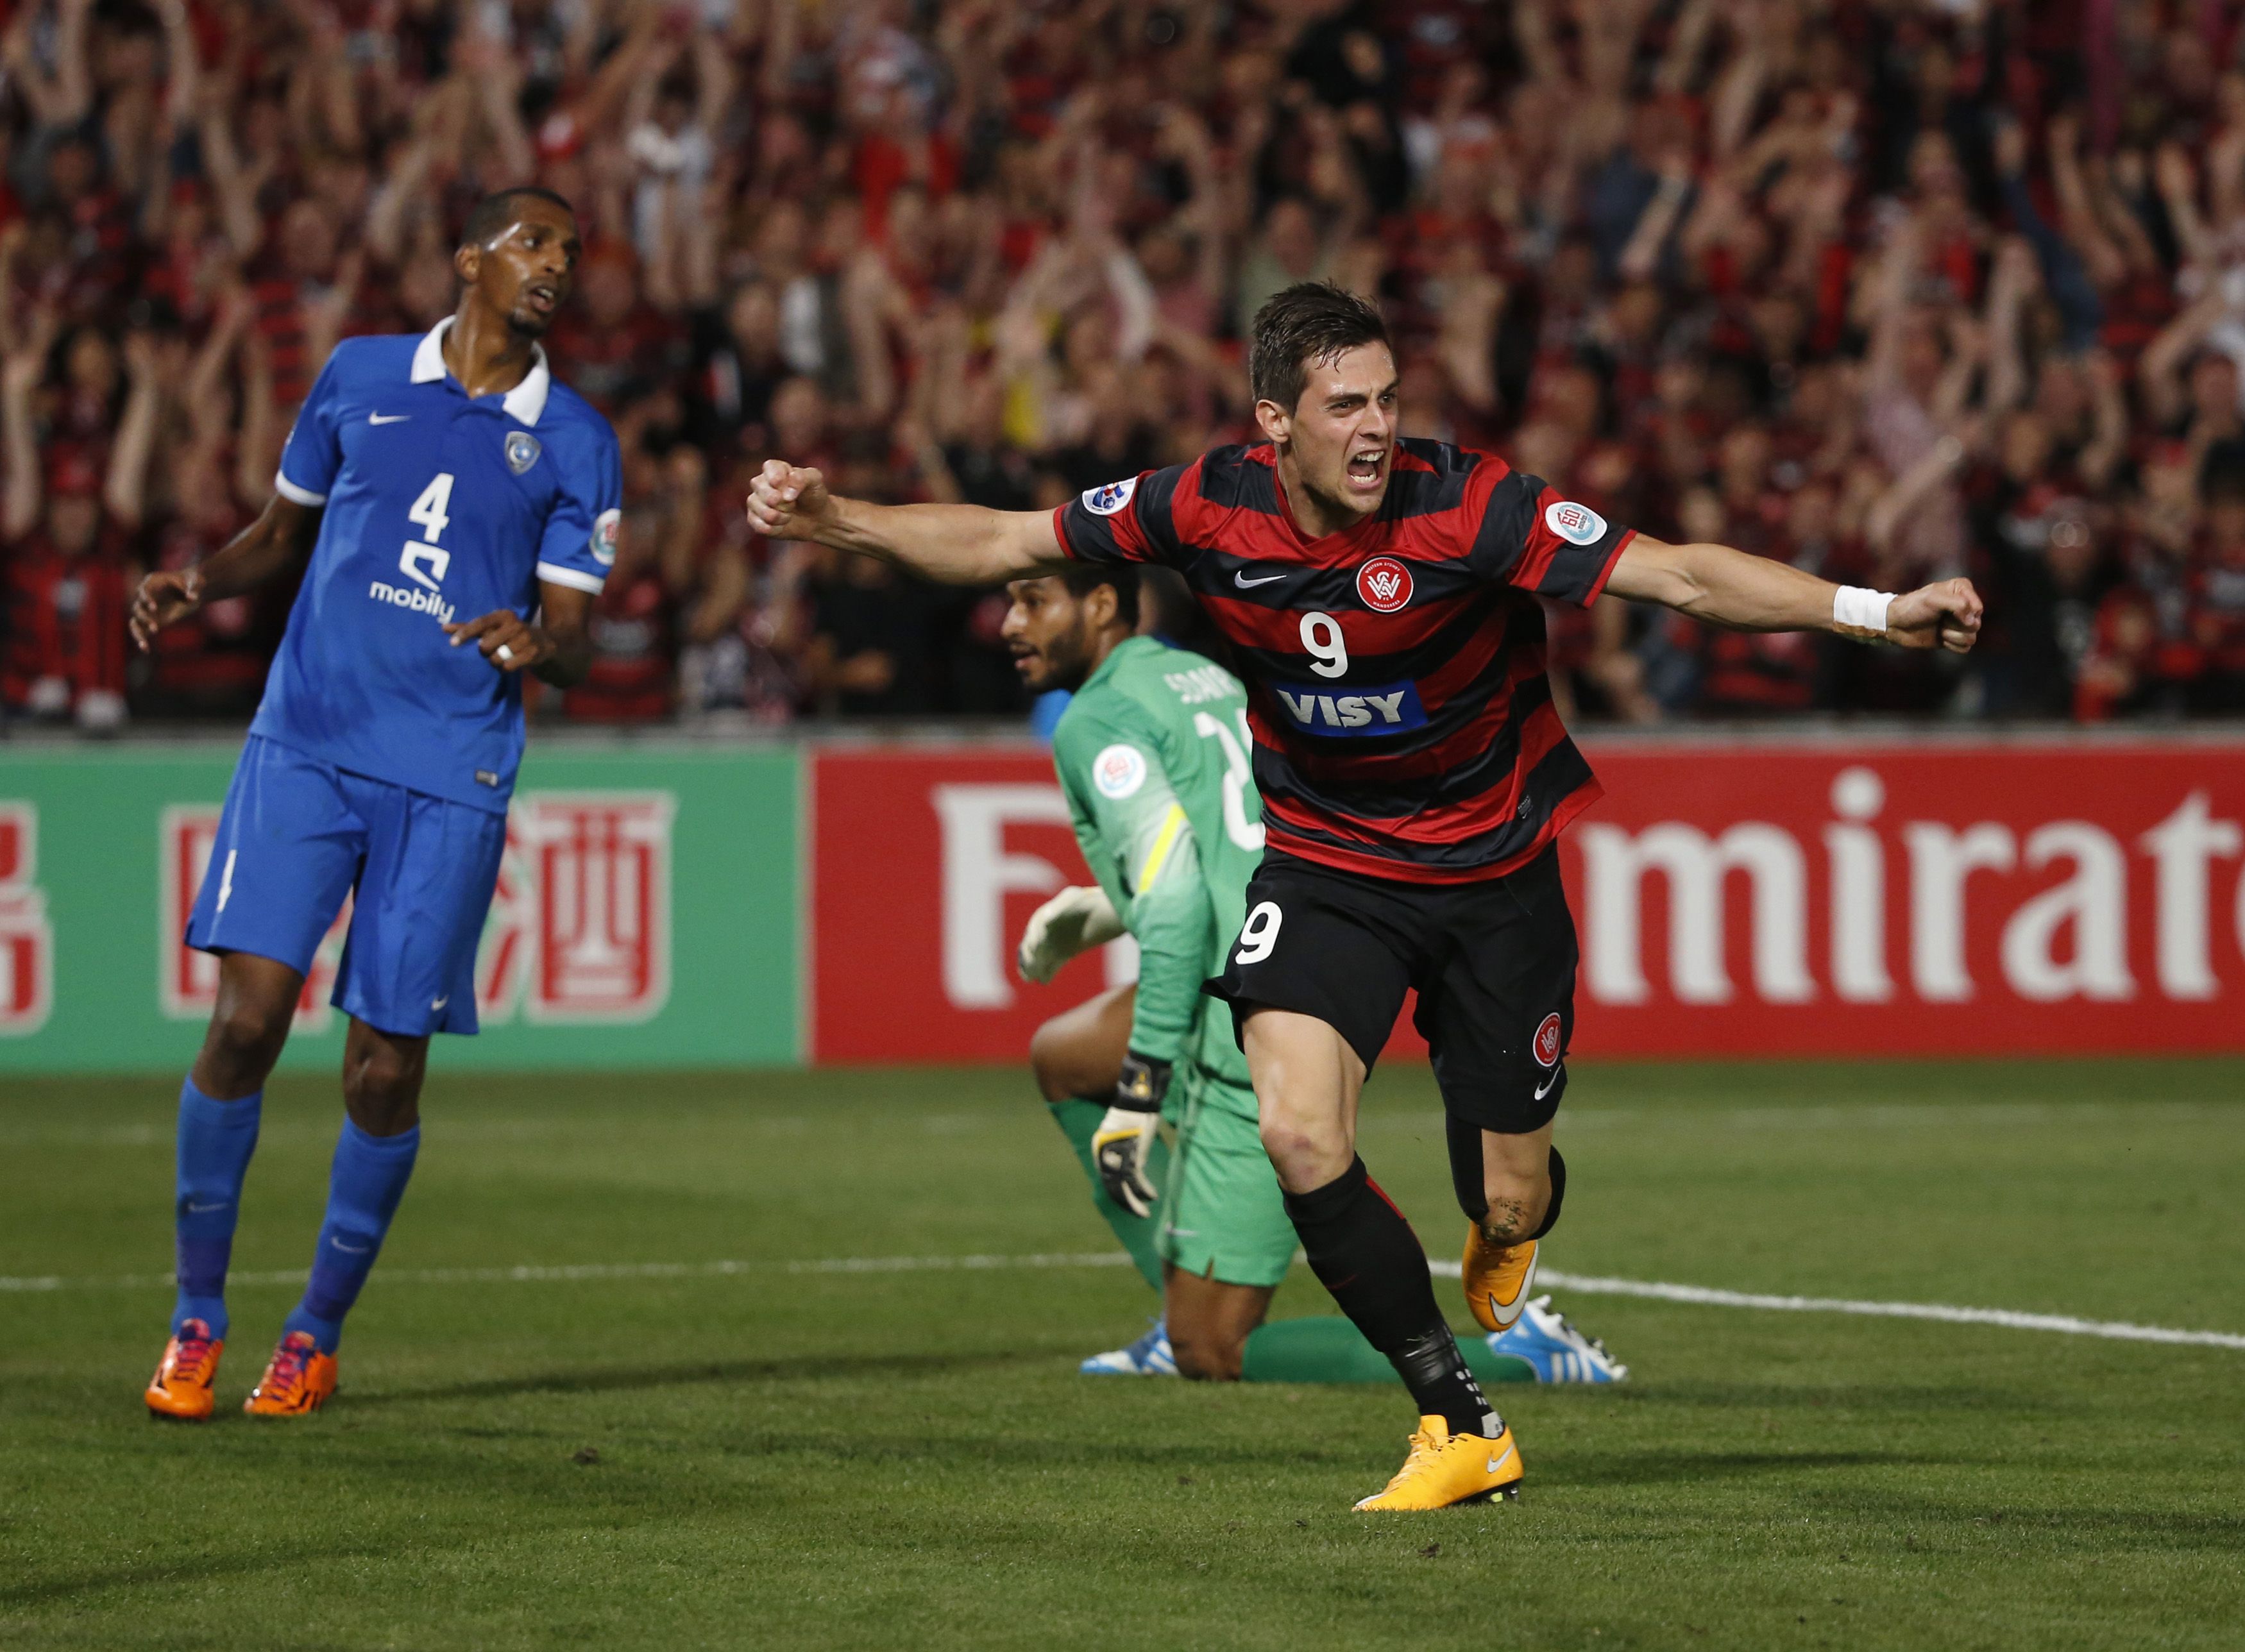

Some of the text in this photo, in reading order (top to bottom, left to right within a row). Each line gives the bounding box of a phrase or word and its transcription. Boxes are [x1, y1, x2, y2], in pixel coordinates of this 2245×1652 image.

[408, 472, 455, 543] 4
[368, 580, 456, 624] mobily
[1373, 599, 1401, 609] WANDERERS
[1299, 611, 1348, 678] 9
[1276, 688, 1405, 728] VISY
[1192, 707, 1266, 852] 2
[1578, 764, 2245, 1006] mirat
[1234, 900, 1283, 965] 9
